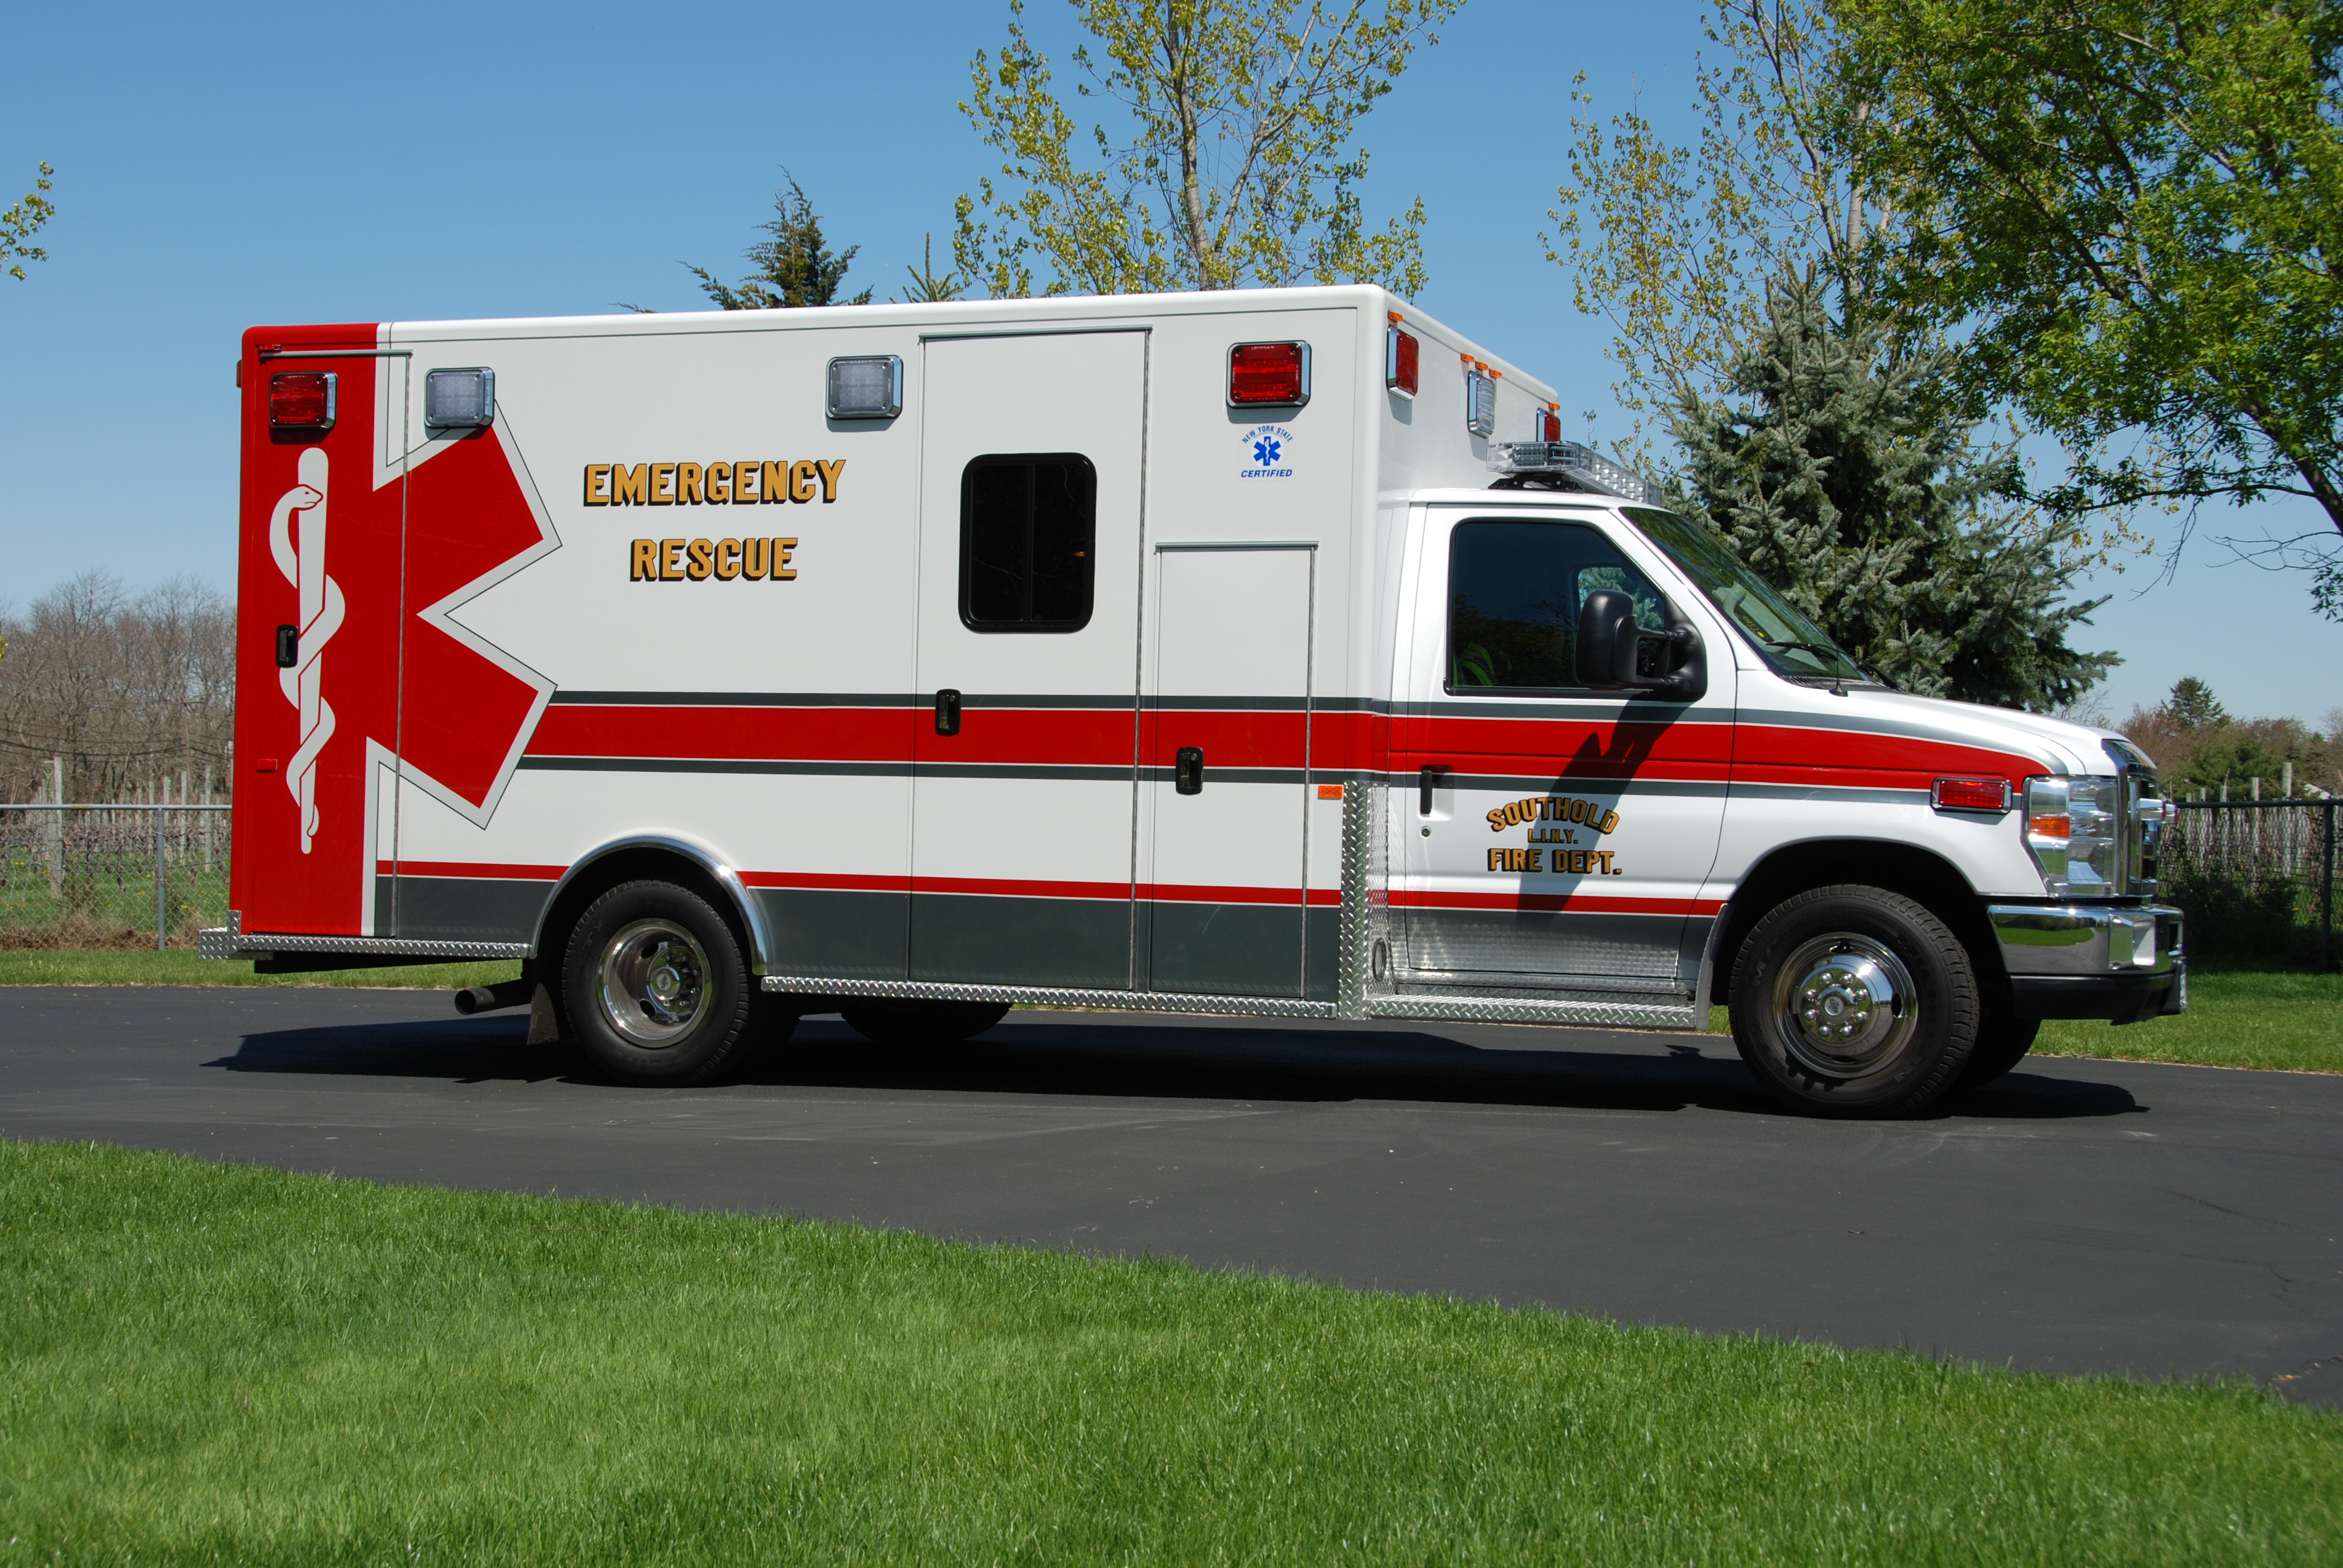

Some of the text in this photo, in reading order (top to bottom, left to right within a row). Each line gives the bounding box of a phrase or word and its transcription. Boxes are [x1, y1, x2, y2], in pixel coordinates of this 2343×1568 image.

[1242, 430, 1256, 443] NEW
[1277, 427, 1293, 442] STATE
[583, 459, 846, 507] EMERGENCY
[1240, 469, 1293, 478] CERTIFIED
[630, 538, 798, 582] RESCUE
[1486, 797, 1620, 835] SOUTHOLD
[1527, 829, 1578, 844] L.I.N.Y.
[1487, 848, 1622, 875] FIRE DEPT.
